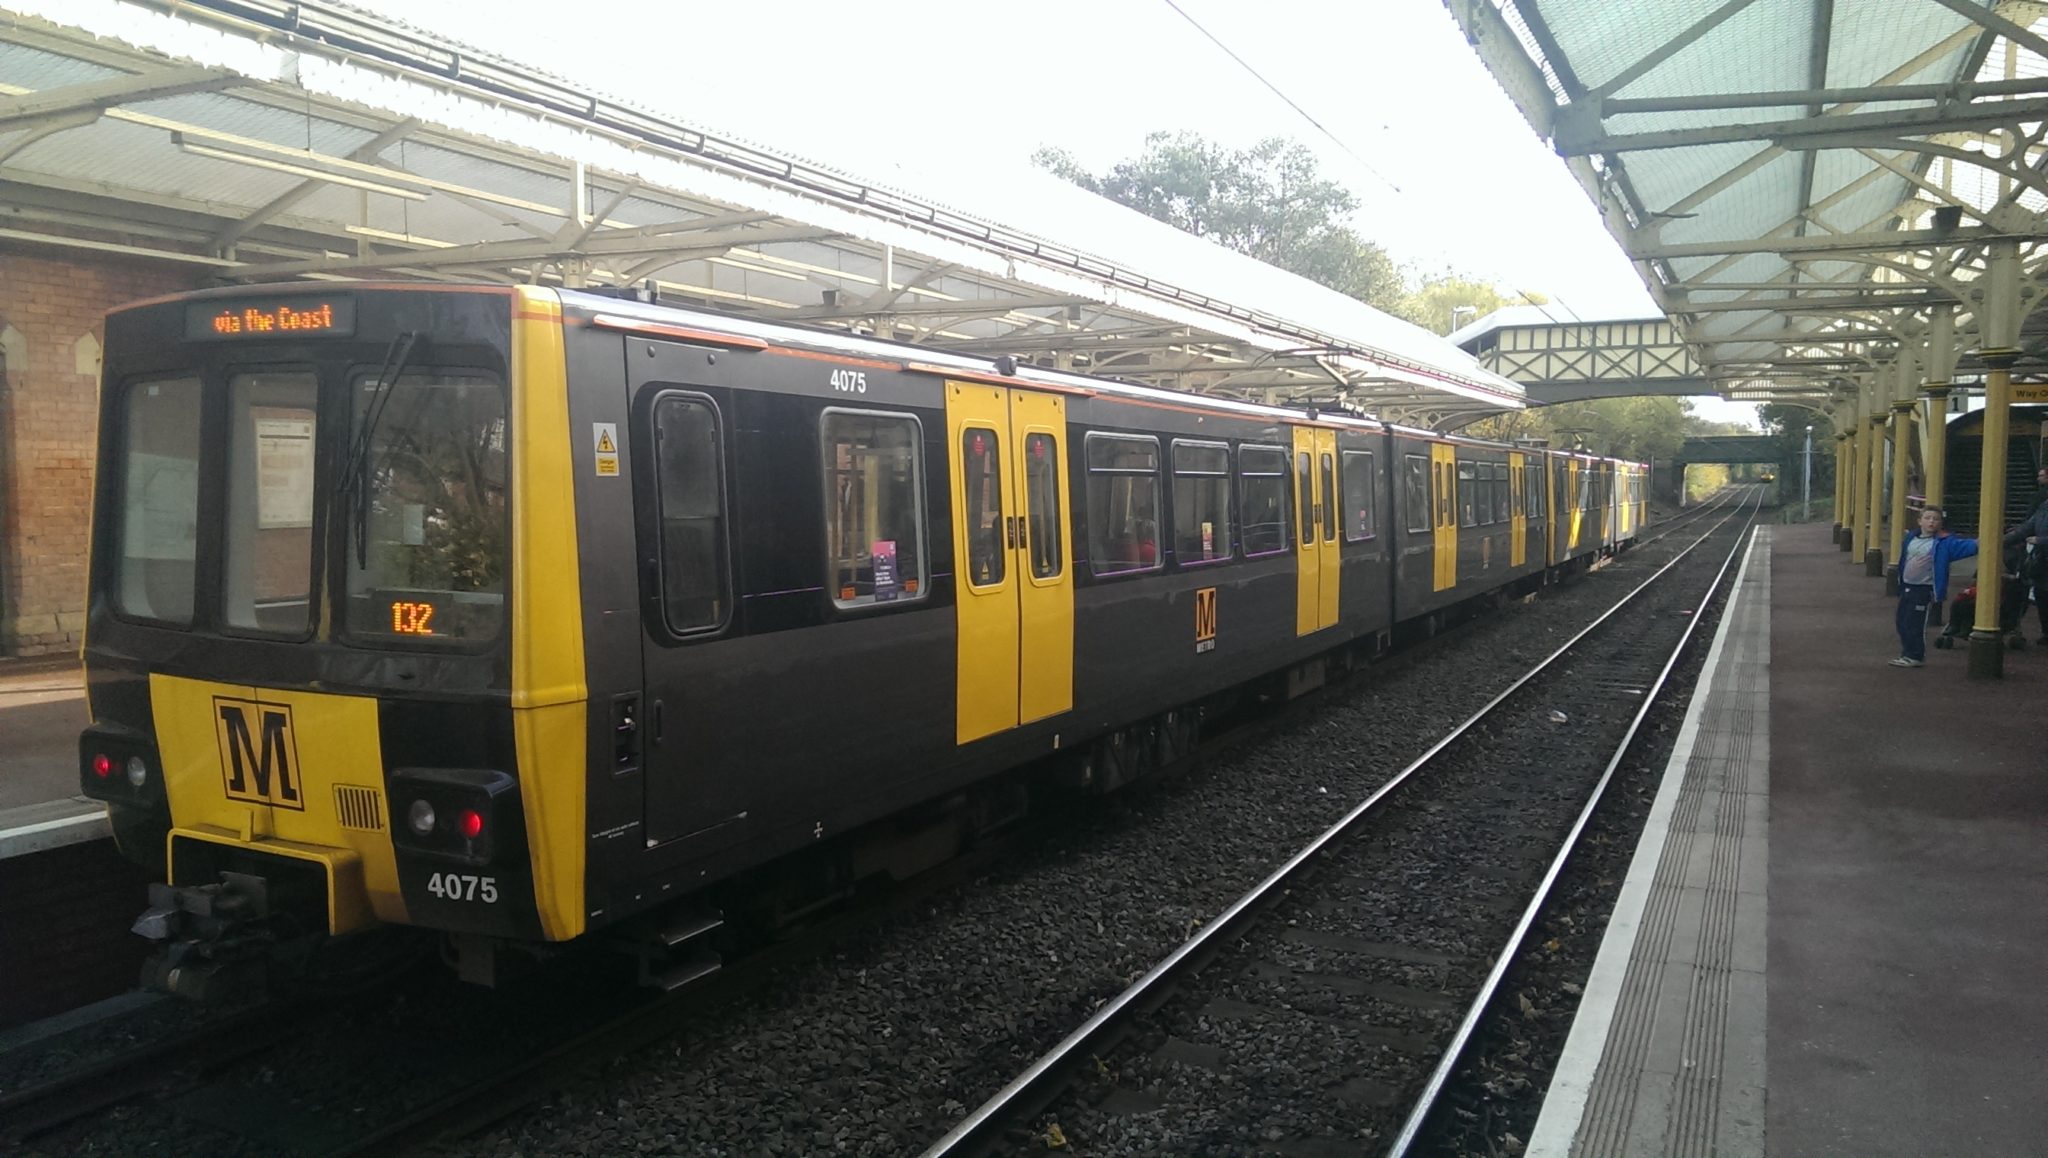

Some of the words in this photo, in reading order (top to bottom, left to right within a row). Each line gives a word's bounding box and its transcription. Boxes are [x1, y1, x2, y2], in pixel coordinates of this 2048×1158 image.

[214, 310, 240, 332] via
[245, 309, 274, 331] the
[280, 304, 332, 329] Coast
[830, 368, 867, 394] 4075
[1951, 396, 1959, 412] 1
[391, 602, 433, 633] 132
[1197, 591, 1215, 638] M
[1197, 639, 1215, 653] METRO
[219, 705, 298, 802] M
[427, 872, 498, 904] 4075
